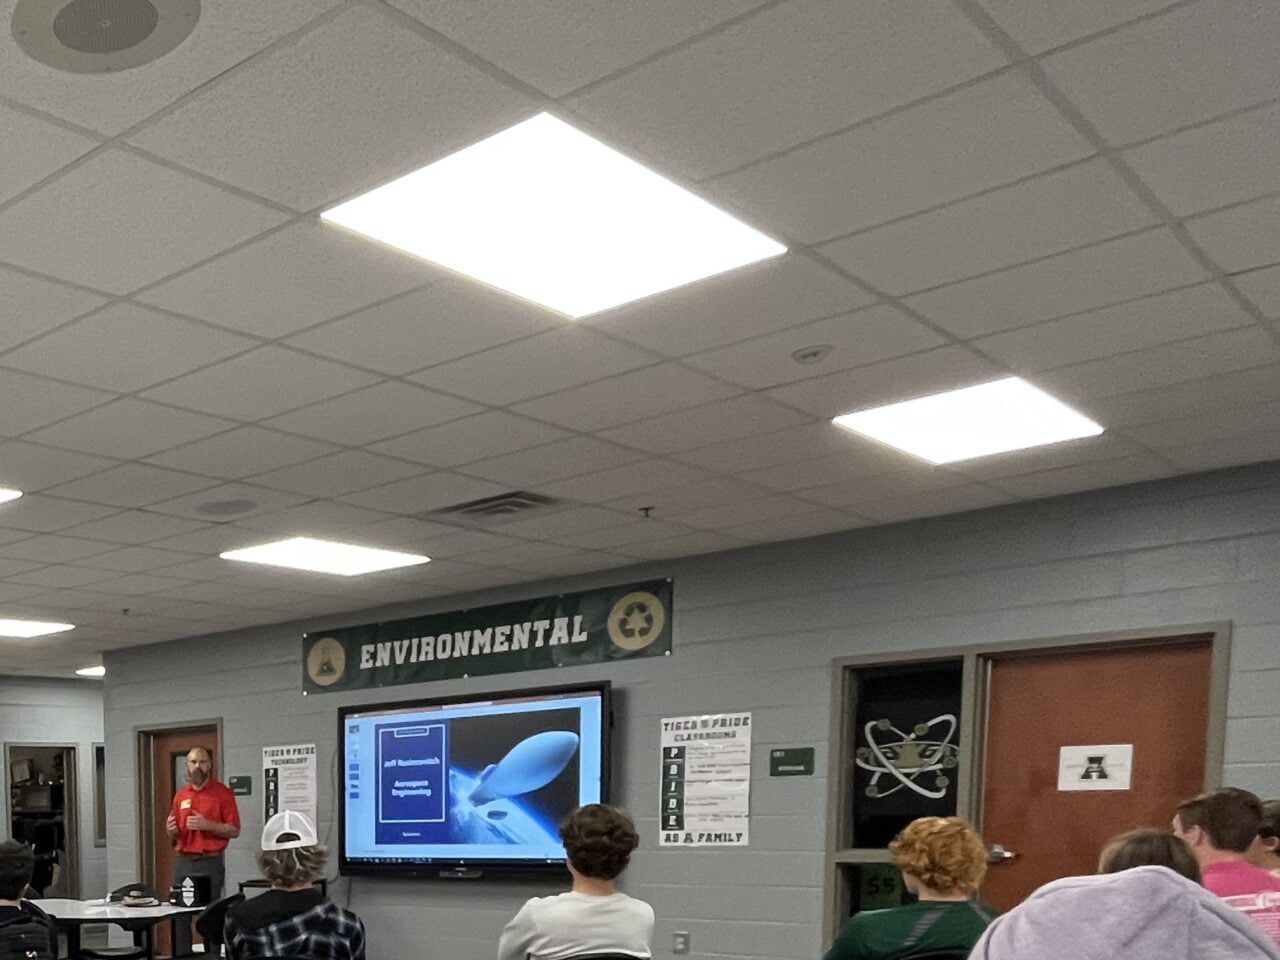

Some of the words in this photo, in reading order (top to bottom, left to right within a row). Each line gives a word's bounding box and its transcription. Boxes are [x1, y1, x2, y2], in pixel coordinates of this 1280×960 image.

[360, 615, 588, 669] ENVIRONMENTAL
[663, 720, 698, 732] TIGER
[711, 716, 750, 729] PRIDE
[1080, 755, 1109, 780] A
[664, 833, 680, 843] AS
[697, 832, 743, 843] FAMILY
